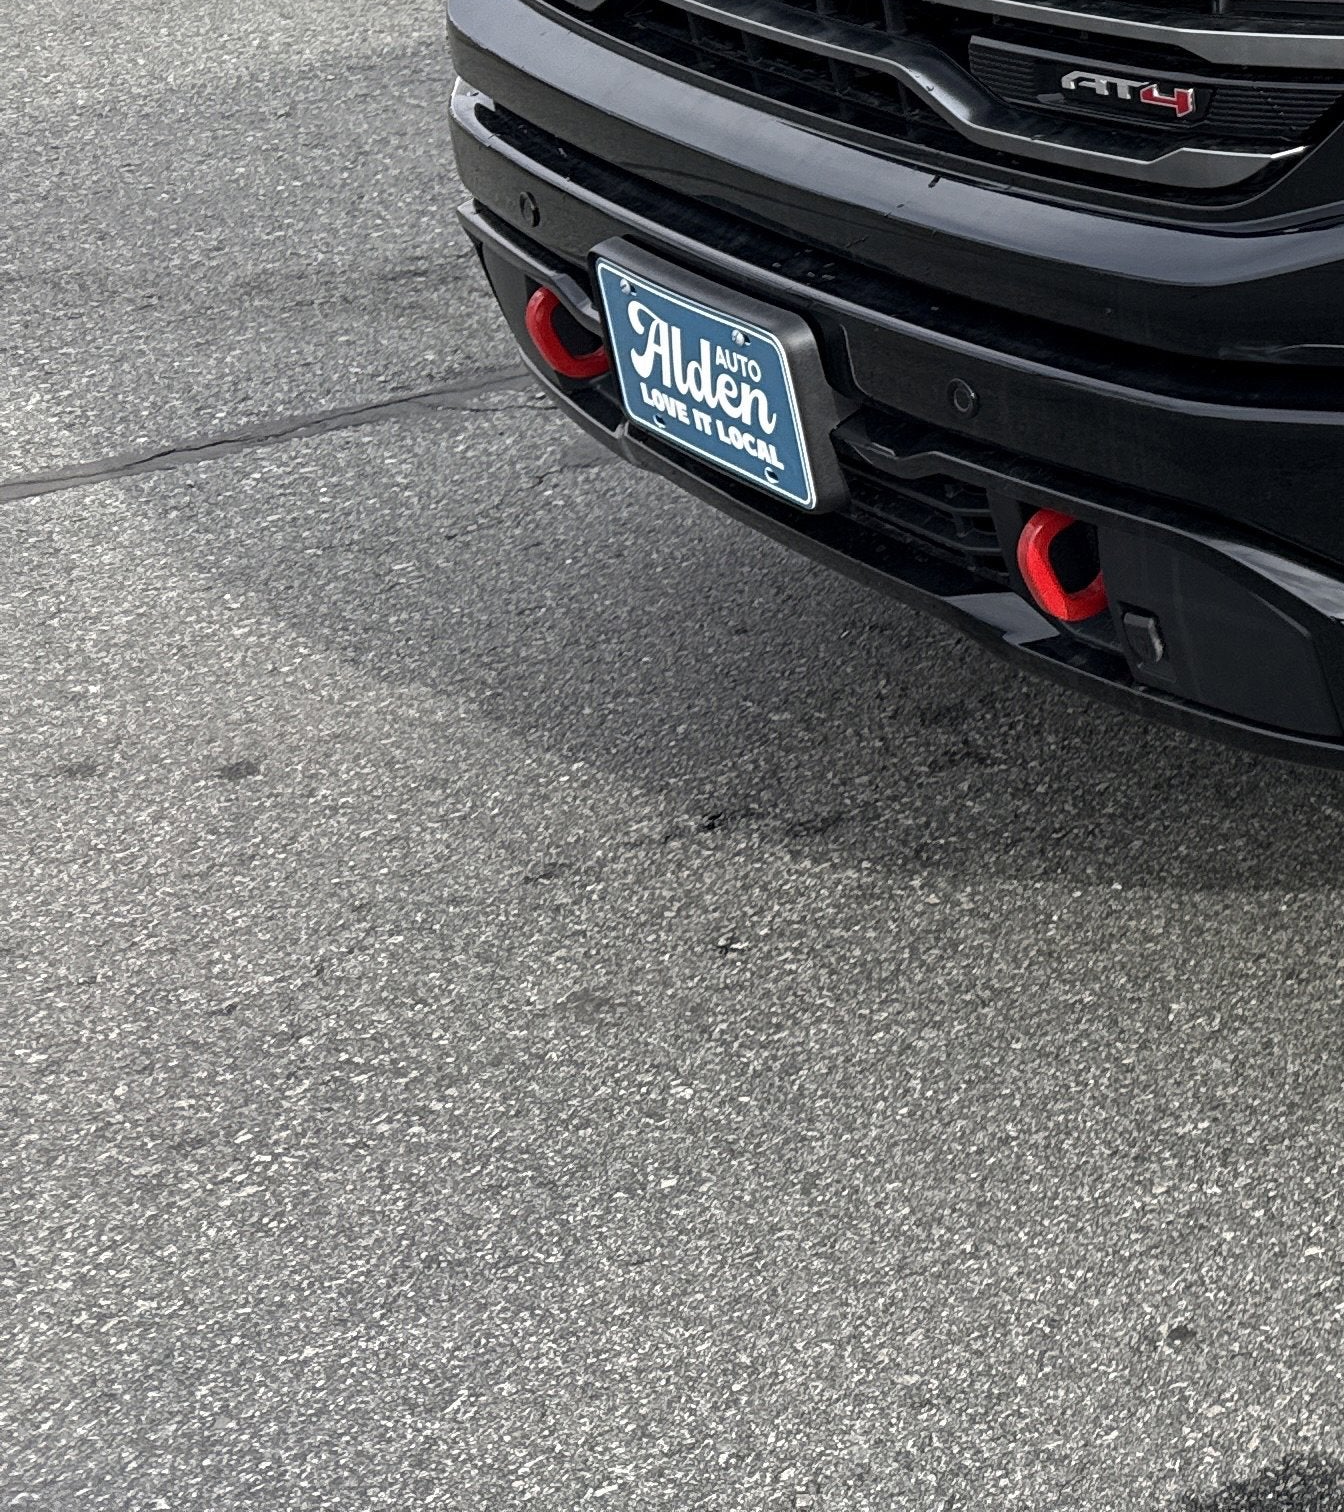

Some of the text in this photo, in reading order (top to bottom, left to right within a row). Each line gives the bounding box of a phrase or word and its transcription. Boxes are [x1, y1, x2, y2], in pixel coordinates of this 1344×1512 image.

[1061, 70, 1194, 118] AT4
[627, 300, 777, 435] Alden
[715, 345, 762, 383] AUTO
[640, 382, 785, 471] LOVE IT LOCAL
